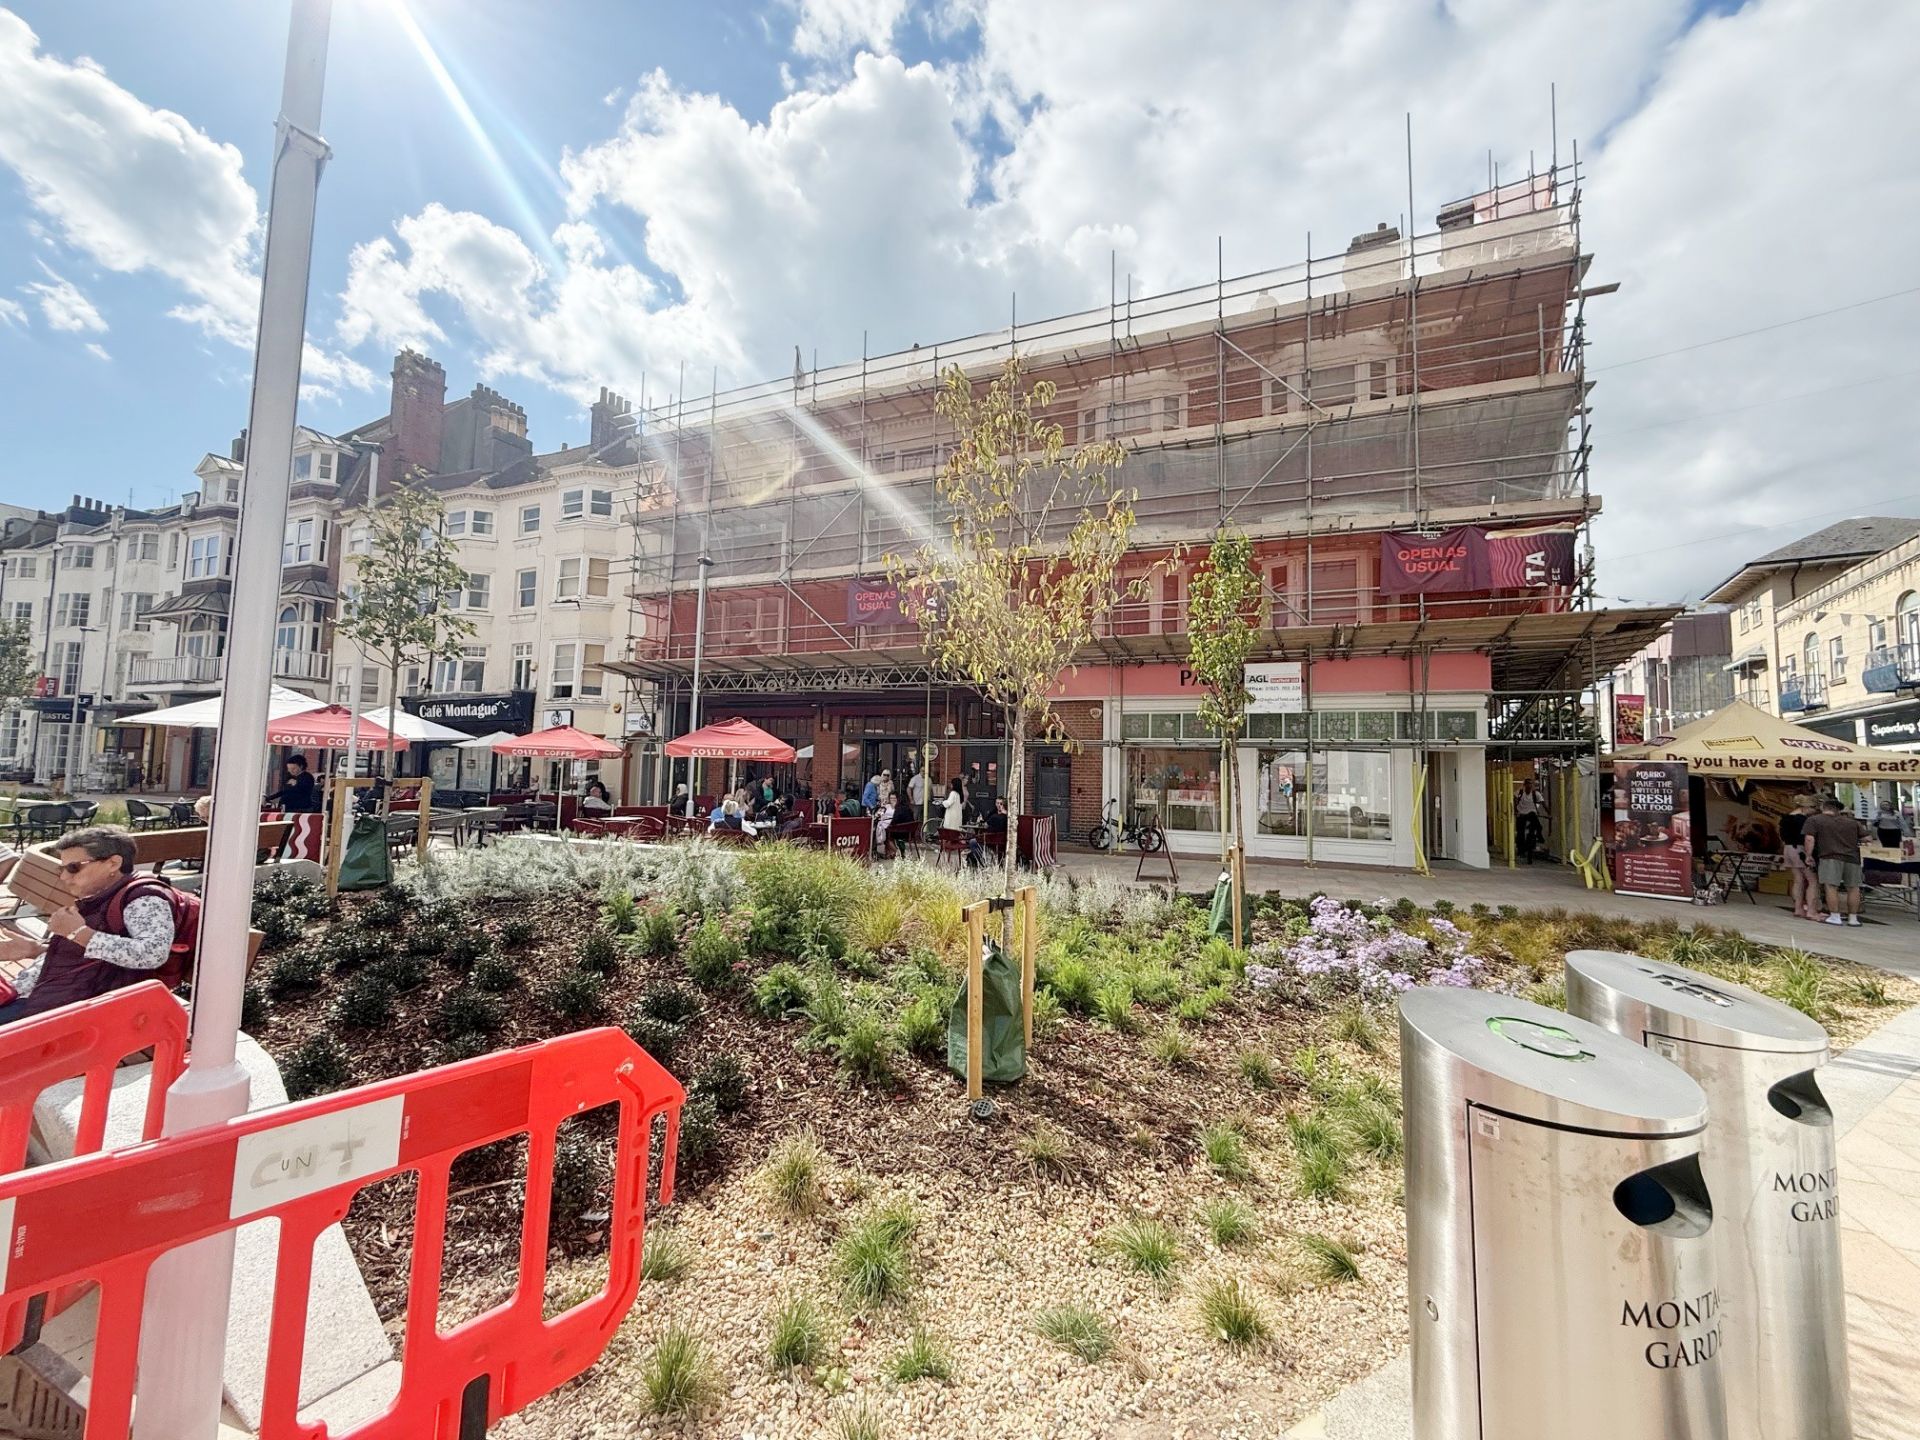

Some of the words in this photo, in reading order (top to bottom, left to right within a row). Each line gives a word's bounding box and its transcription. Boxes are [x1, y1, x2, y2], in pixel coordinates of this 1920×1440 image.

[1397, 547, 1444, 561] OPEN
[1445, 546, 1467, 557] AS
[1405, 561, 1460, 574] USUAL
[855, 592, 884, 601] OPEN
[883, 590, 896, 599] AS
[859, 602, 892, 612] USUAL
[1249, 675, 1268, 683] AGL
[445, 702, 498, 719] Montague
[272, 735, 317, 745] COSTA
[511, 748, 539, 756] COSTA
[691, 747, 724, 756] COSTA
[1693, 757, 1723, 770] you
[1729, 755, 1769, 769] have
[1775, 758, 1786, 769] a
[1792, 756, 1826, 773] dog
[1831, 760, 1853, 771] or
[1859, 761, 1871, 772] a
[1877, 758, 1920, 772] cat?
[1656, 780, 1673, 788] THE
[1631, 793, 1673, 805] FRESH
[836, 835, 860, 847] COSTA
